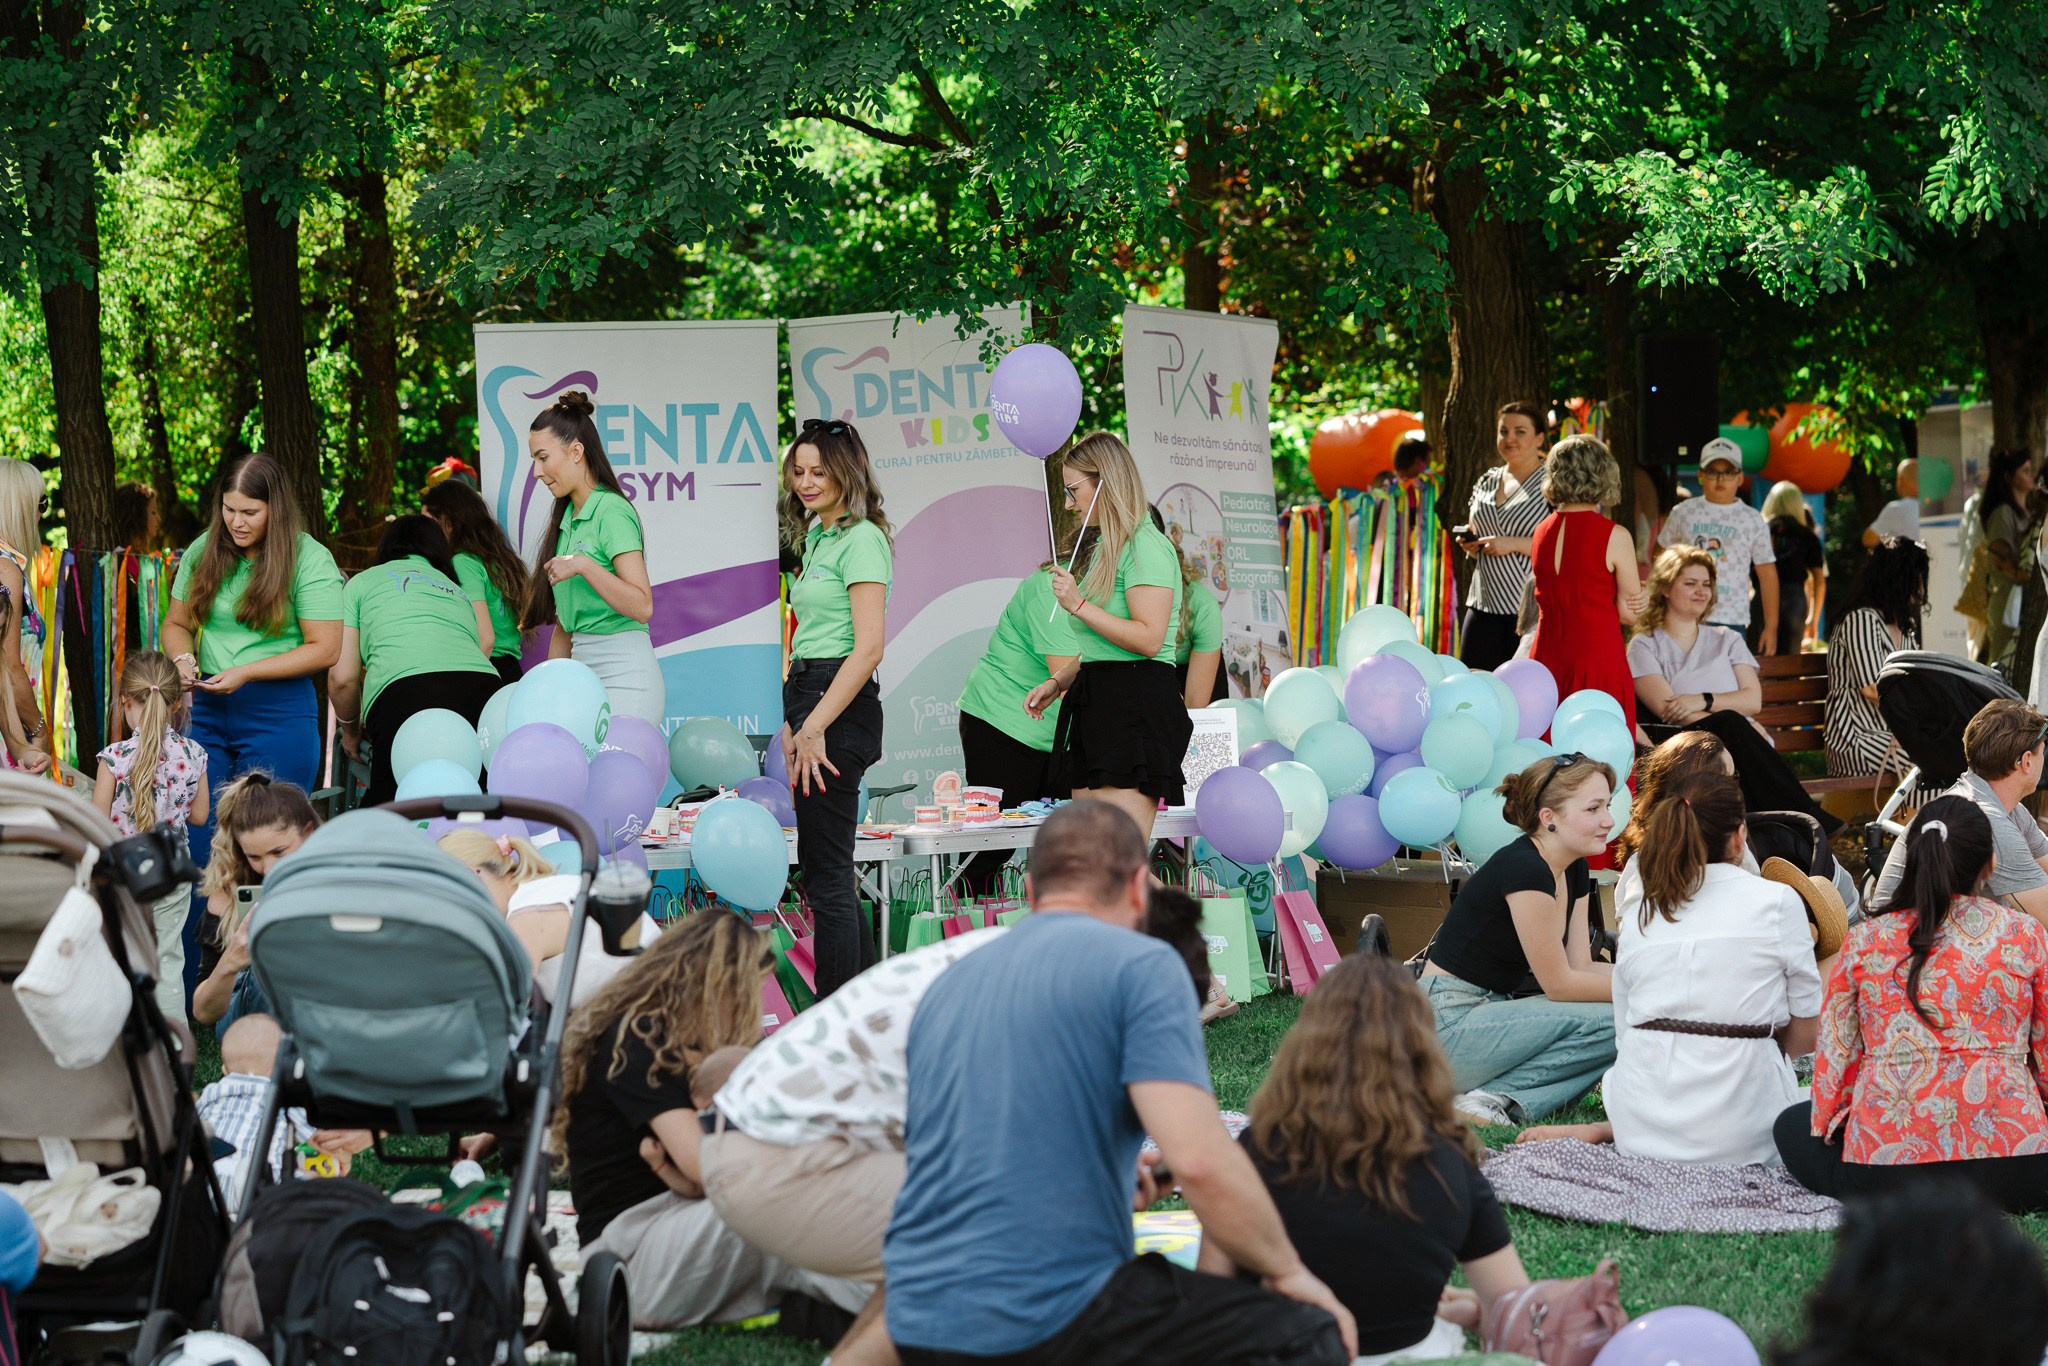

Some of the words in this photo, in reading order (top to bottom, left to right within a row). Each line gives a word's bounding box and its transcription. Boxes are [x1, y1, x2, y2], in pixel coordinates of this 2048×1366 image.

[853, 363, 992, 419] DENT
[596, 402, 774, 466] ENTA
[900, 413, 990, 449] KIDS
[1154, 431, 1169, 445] Ne
[875, 454, 913, 469] CURAJ
[915, 451, 962, 467] PENTRU
[1223, 494, 1271, 512] Pediatrie
[1693, 522, 1738, 538] MINECRAFT
[1227, 546, 1250, 561] ORL
[1229, 570, 1280, 587] Ecografie
[925, 701, 957, 717] DEN
[894, 743, 962, 760] www.den
